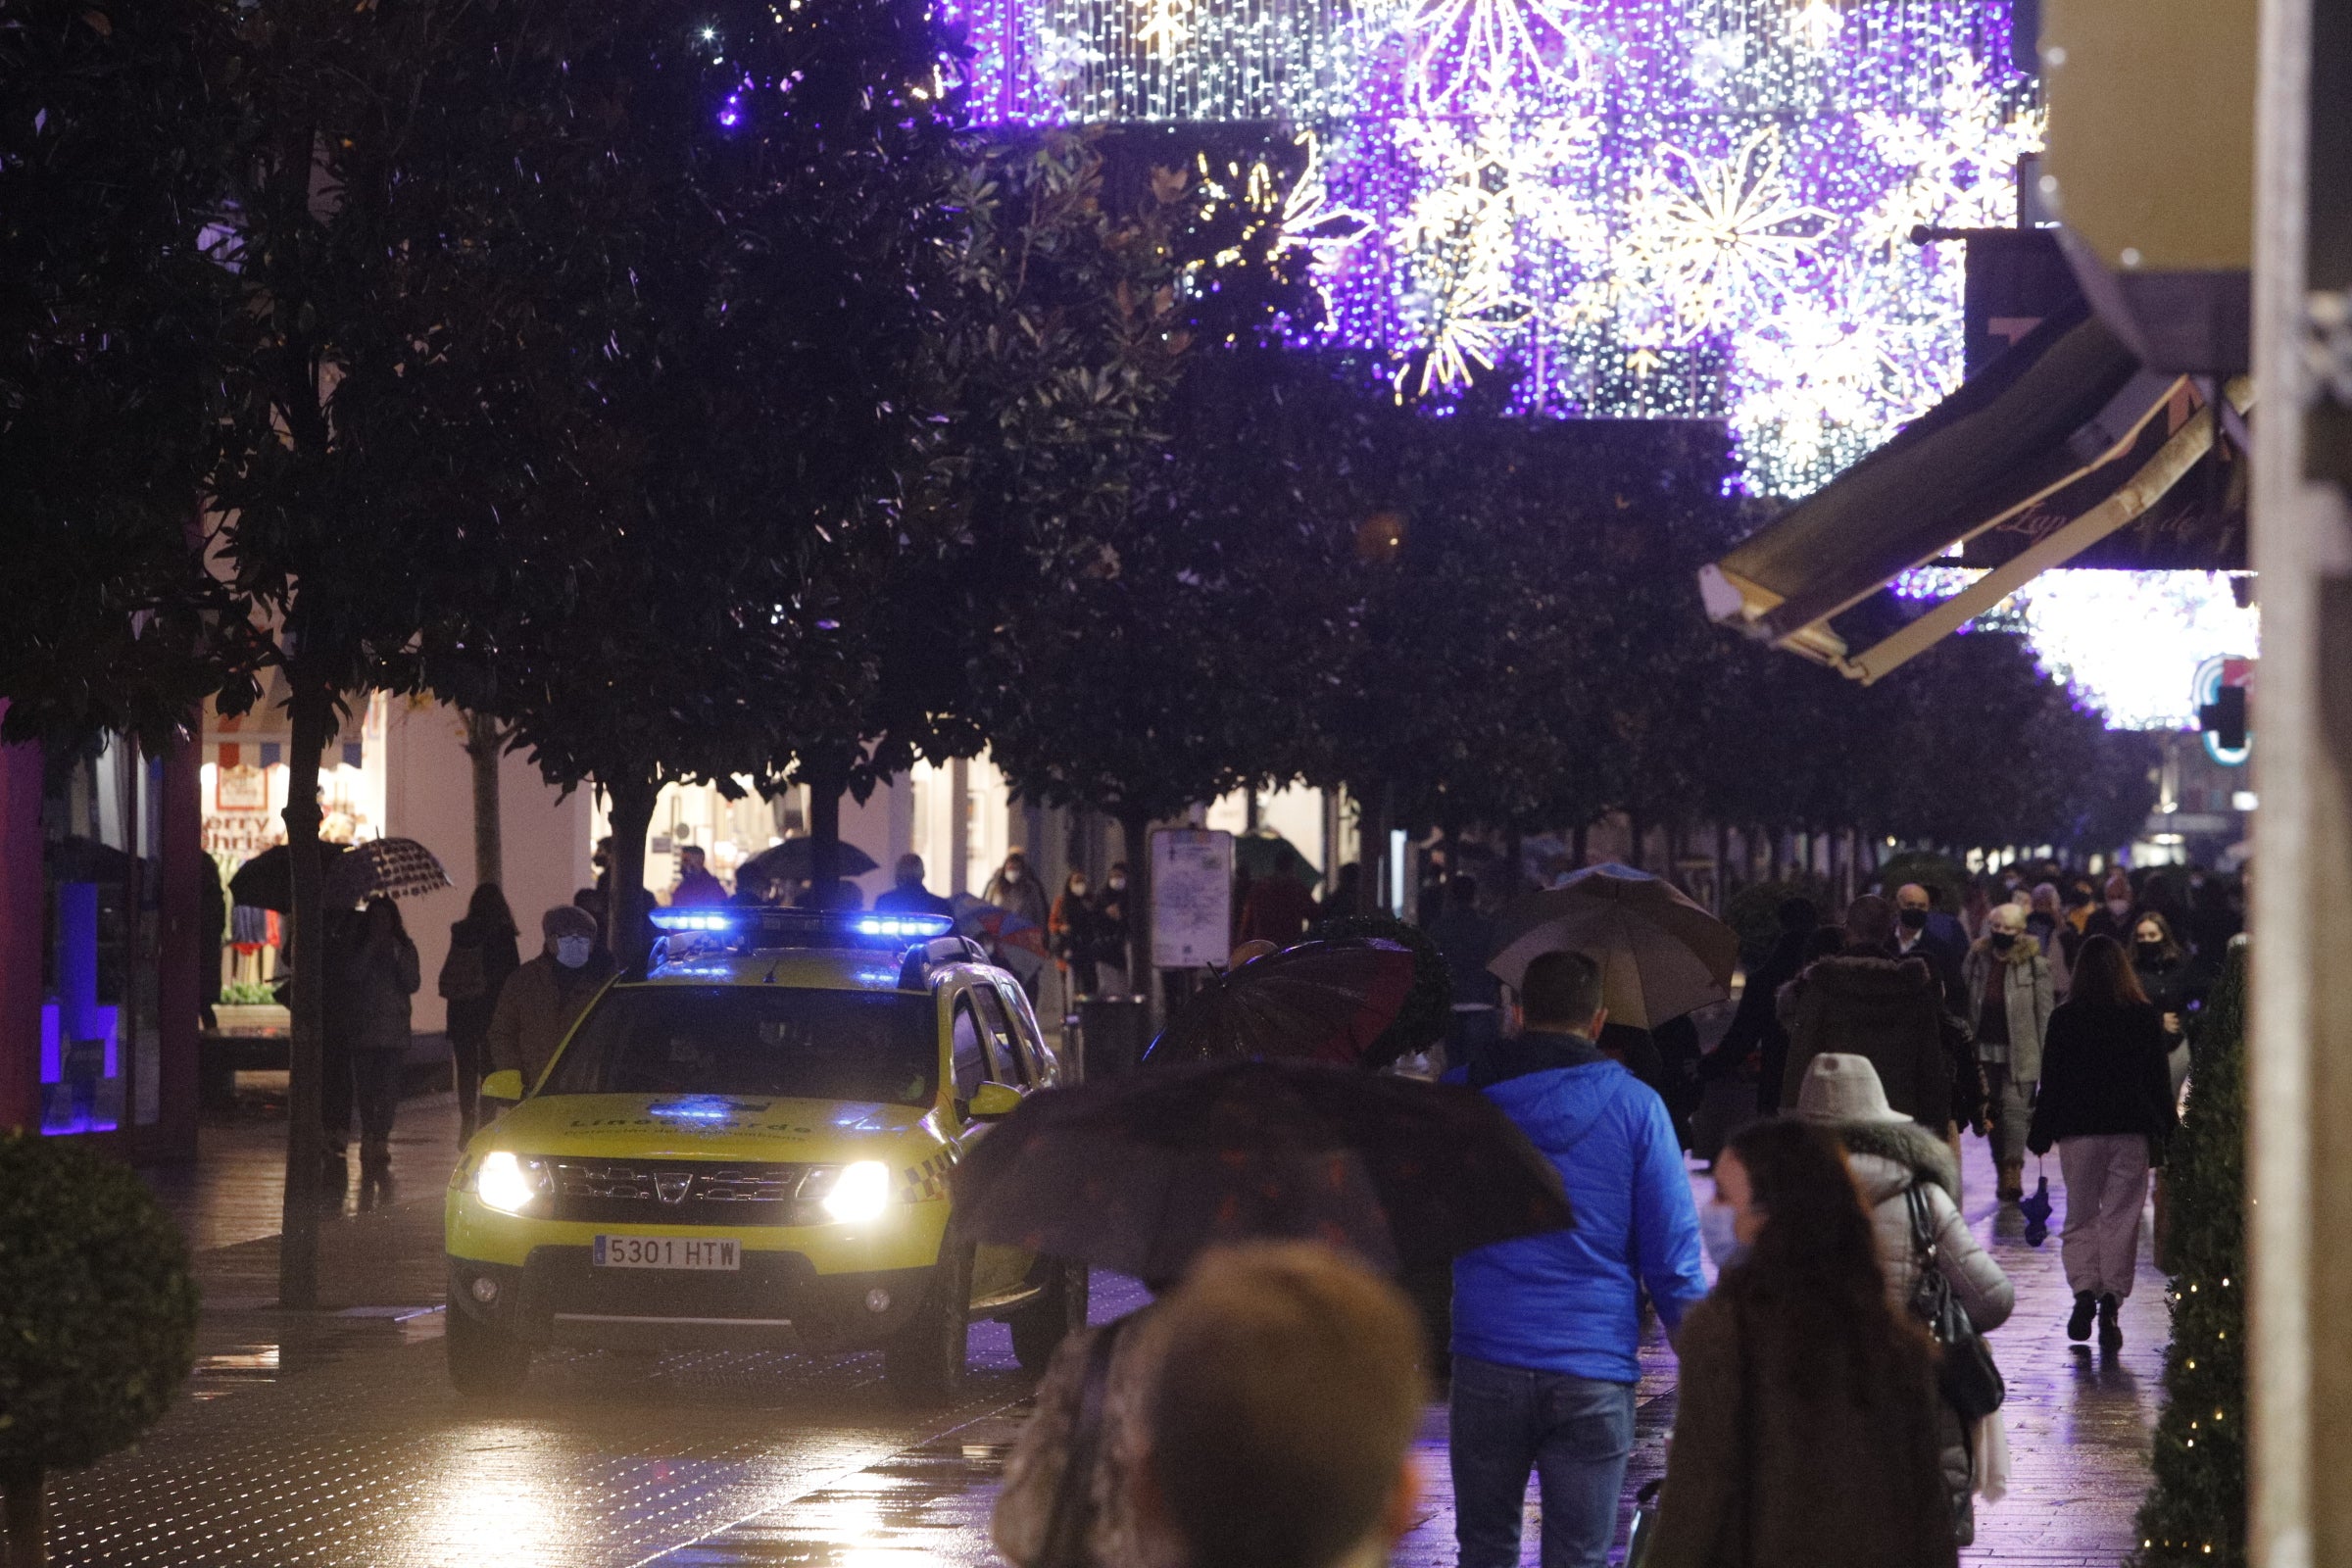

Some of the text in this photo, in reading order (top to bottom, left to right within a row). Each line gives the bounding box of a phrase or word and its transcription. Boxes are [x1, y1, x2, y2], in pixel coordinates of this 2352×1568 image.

[202, 814, 270, 832] erry
[611, 1239, 734, 1266] 5301 HTW
